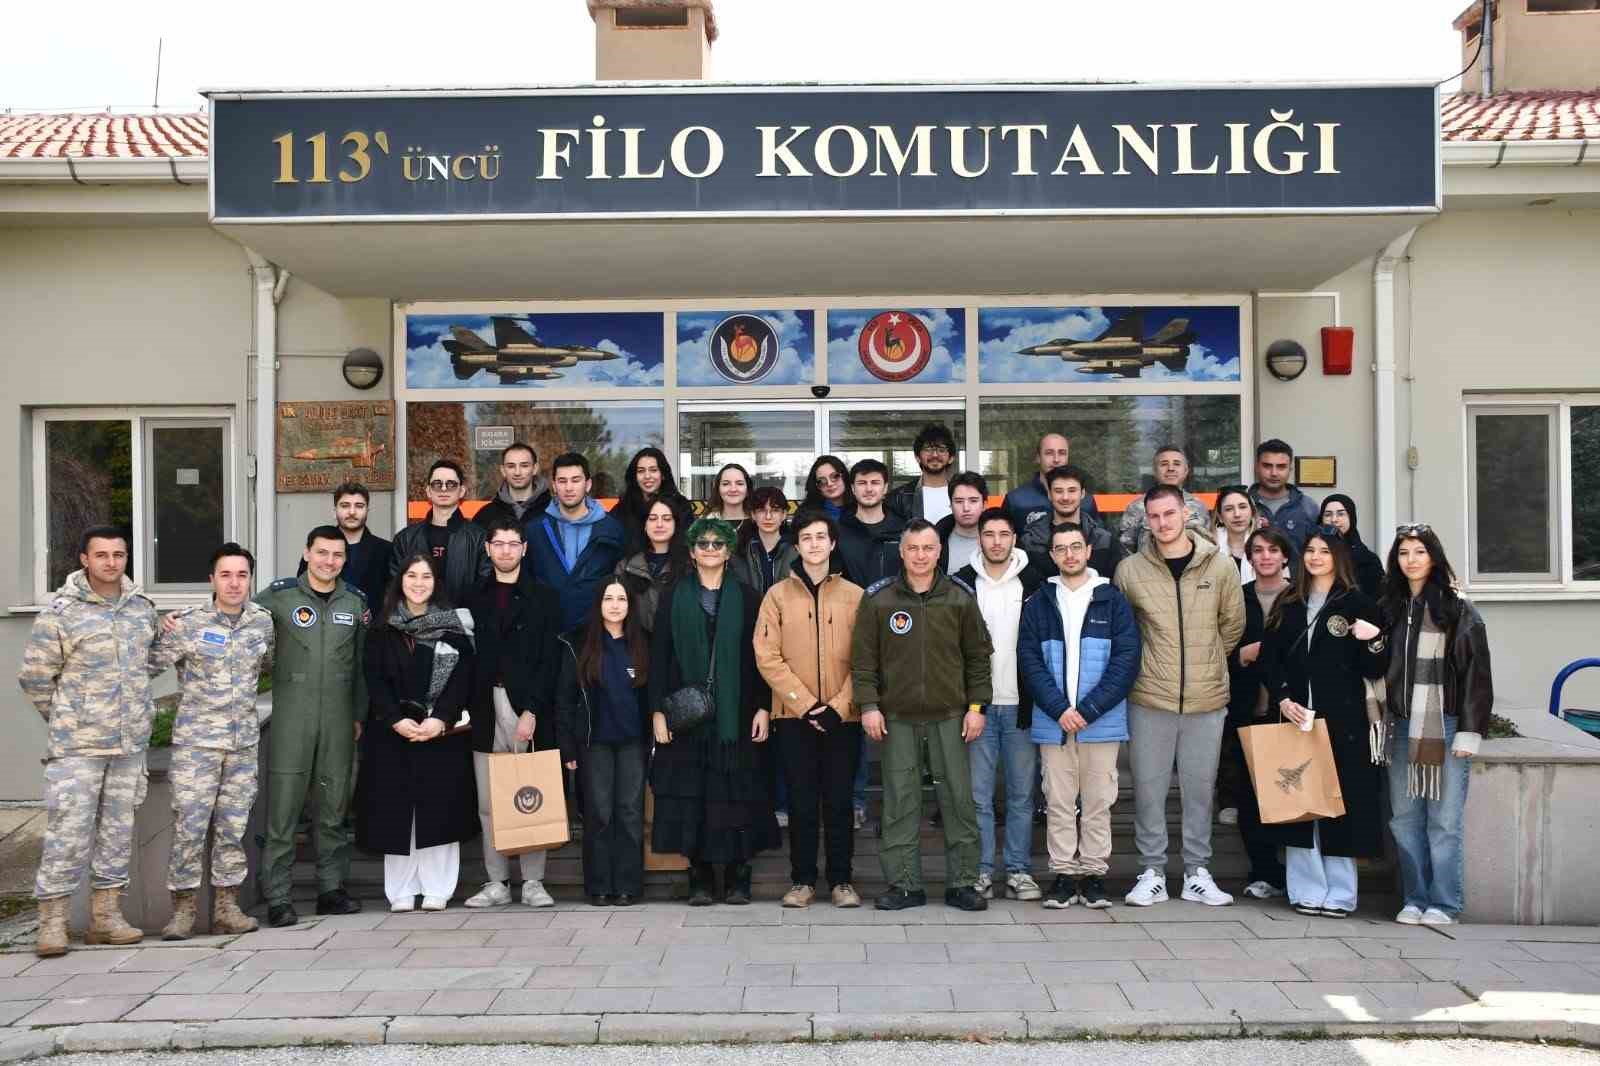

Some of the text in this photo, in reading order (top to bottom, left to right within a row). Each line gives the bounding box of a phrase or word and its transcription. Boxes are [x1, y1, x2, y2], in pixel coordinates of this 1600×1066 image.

[401, 145, 500, 181] ÜNCÜ
[536, 114, 724, 180] FİLO
[755, 108, 1342, 178] KOMUTANLIĞI
